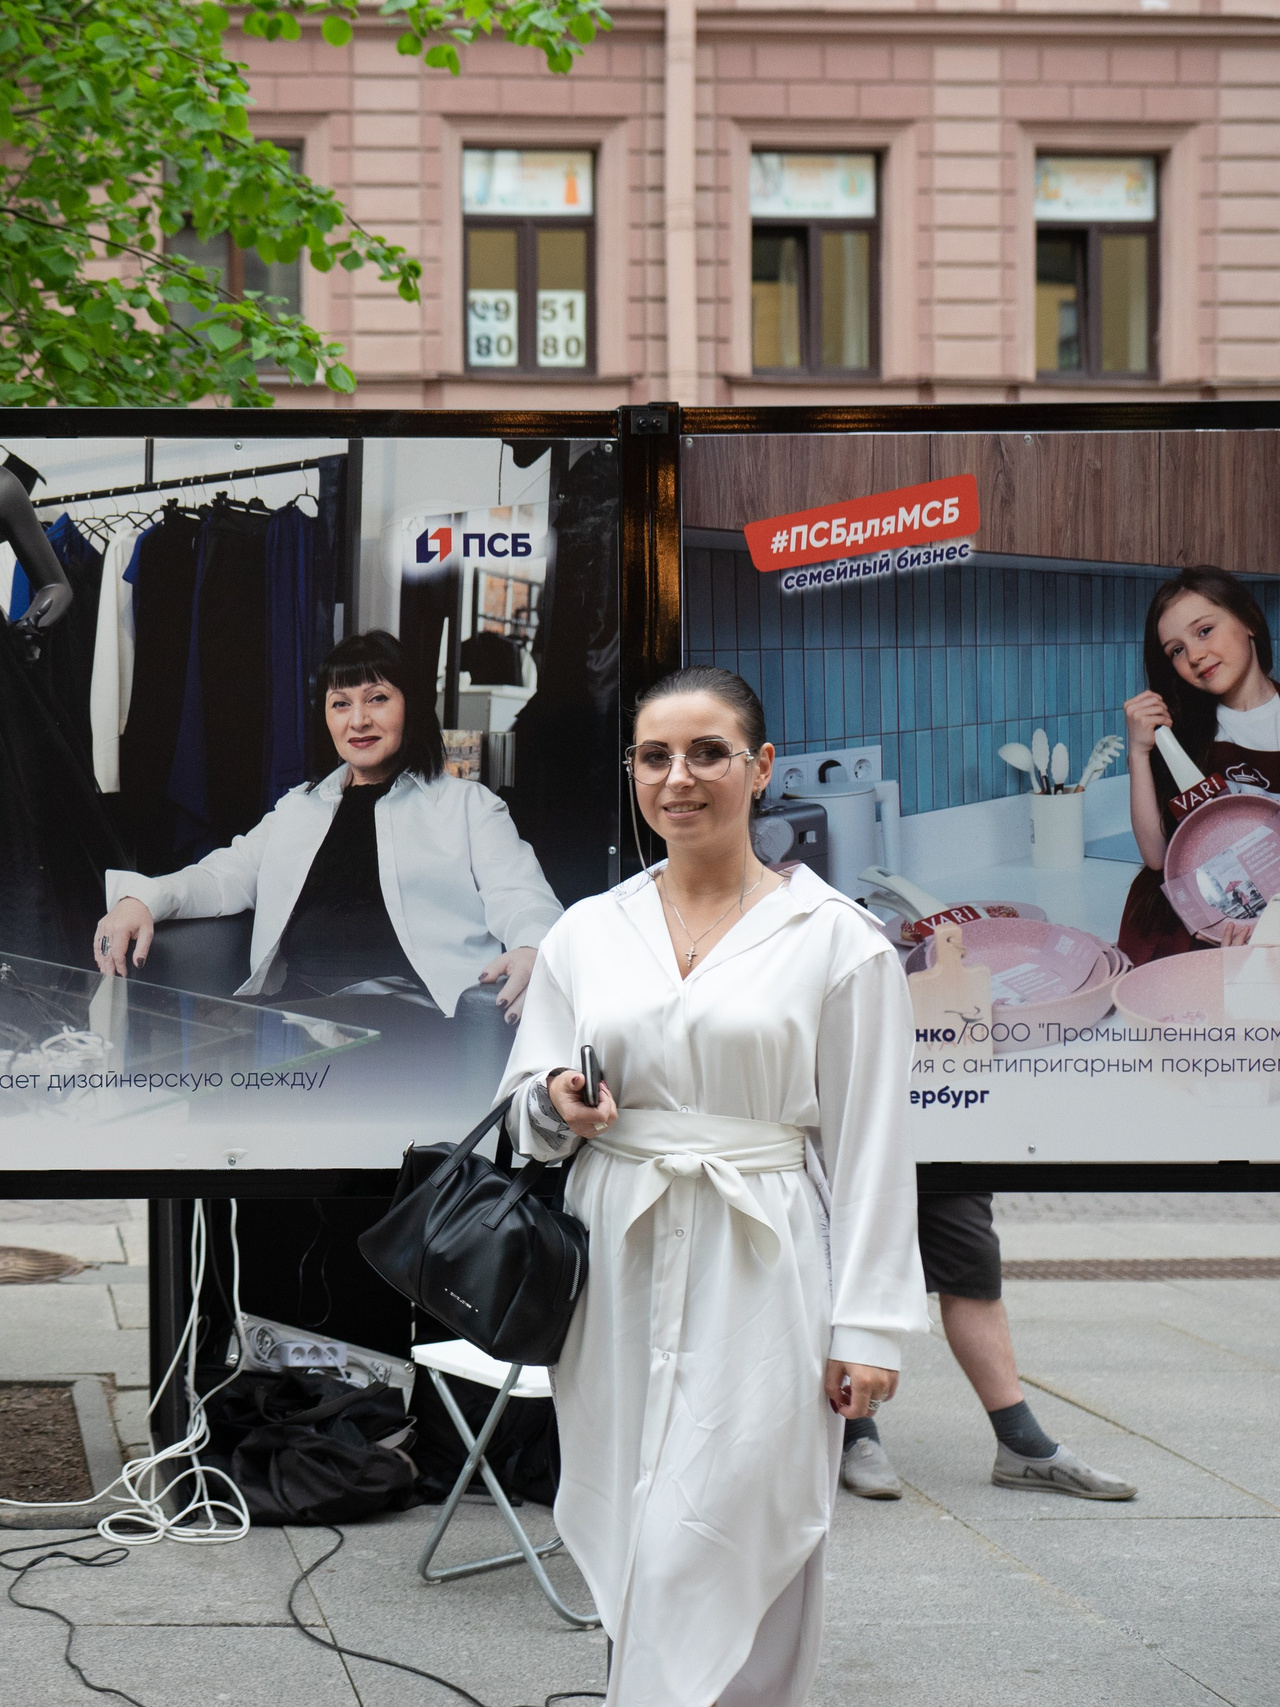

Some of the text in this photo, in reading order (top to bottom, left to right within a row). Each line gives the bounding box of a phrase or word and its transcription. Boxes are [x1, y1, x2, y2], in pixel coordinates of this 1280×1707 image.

[541, 299, 576, 322] 51
[475, 334, 582, 358] 80 80
[770, 496, 961, 554] #ПСБдляМСБ
[462, 532, 533, 558] ПСБ
[783, 542, 970, 590] семейный бизнес
[1173, 776, 1221, 811] VARI
[1038, 1022, 1236, 1046] "Промышленная
[47, 1069, 223, 1093] дизайнерскую
[230, 1065, 331, 1091] одежду/
[942, 1057, 957, 1073] с
[963, 1057, 1153, 1077] антипригарным
[1162, 1057, 1280, 1077] покрытие
